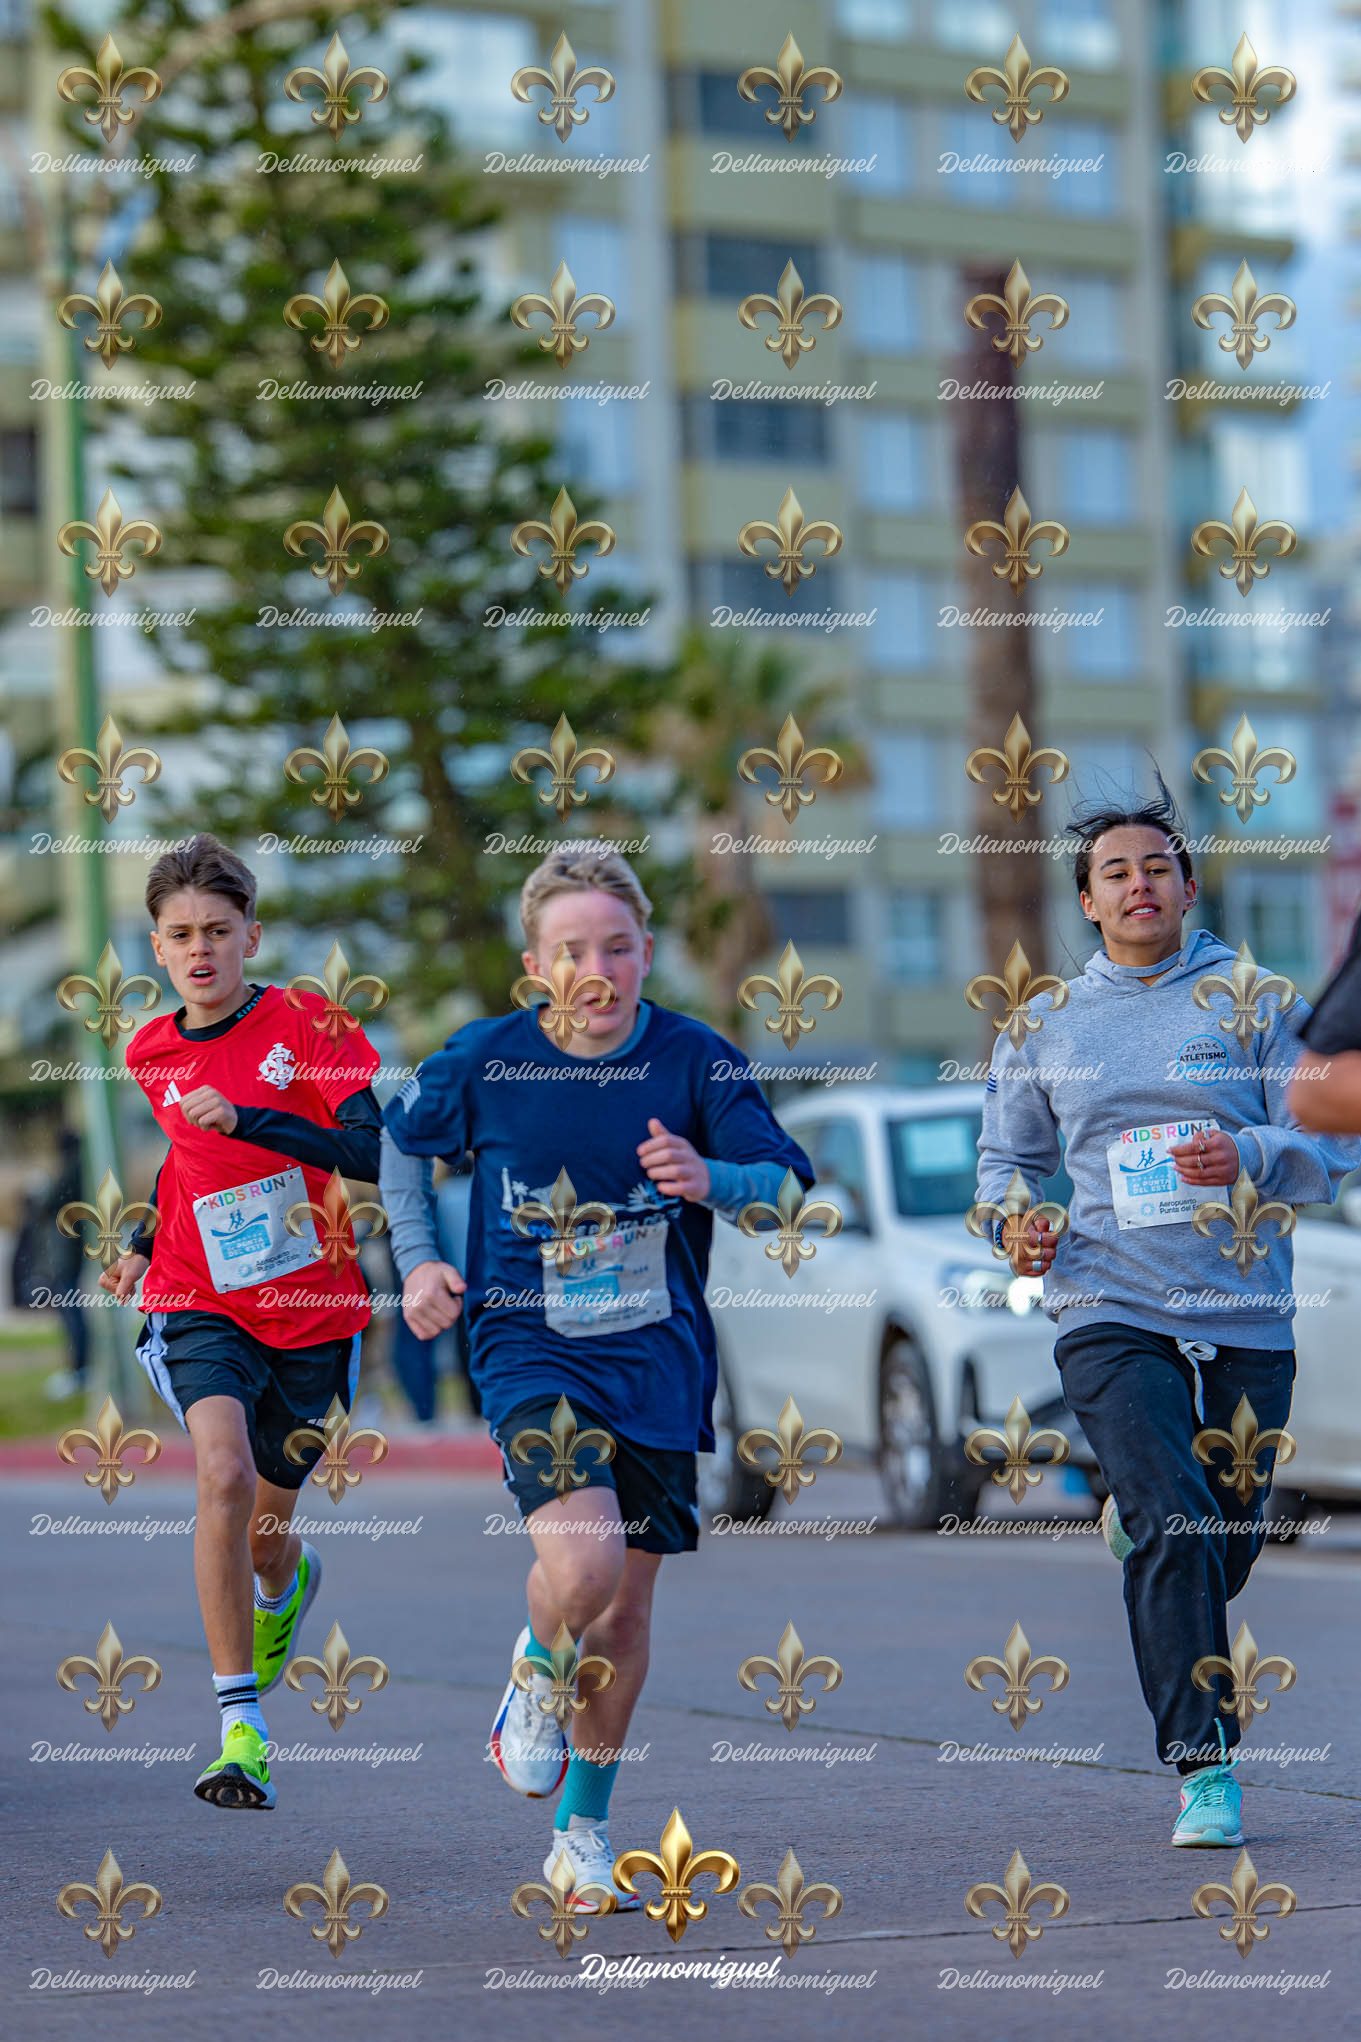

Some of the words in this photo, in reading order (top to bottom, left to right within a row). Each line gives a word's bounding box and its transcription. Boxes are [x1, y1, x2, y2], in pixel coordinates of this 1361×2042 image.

[1180, 1051, 1227, 1062] ATLETISMO
[1122, 1127, 1162, 1144] KIDS
[1166, 1122, 1203, 1139] RUN
[207, 1188, 247, 1210] KIDS
[249, 1176, 287, 1198] RUN
[1159, 1198, 1197, 1208] Aeropuerto
[1159, 1206, 1179, 1215] Punta
[612, 1228, 647, 1248] RUN
